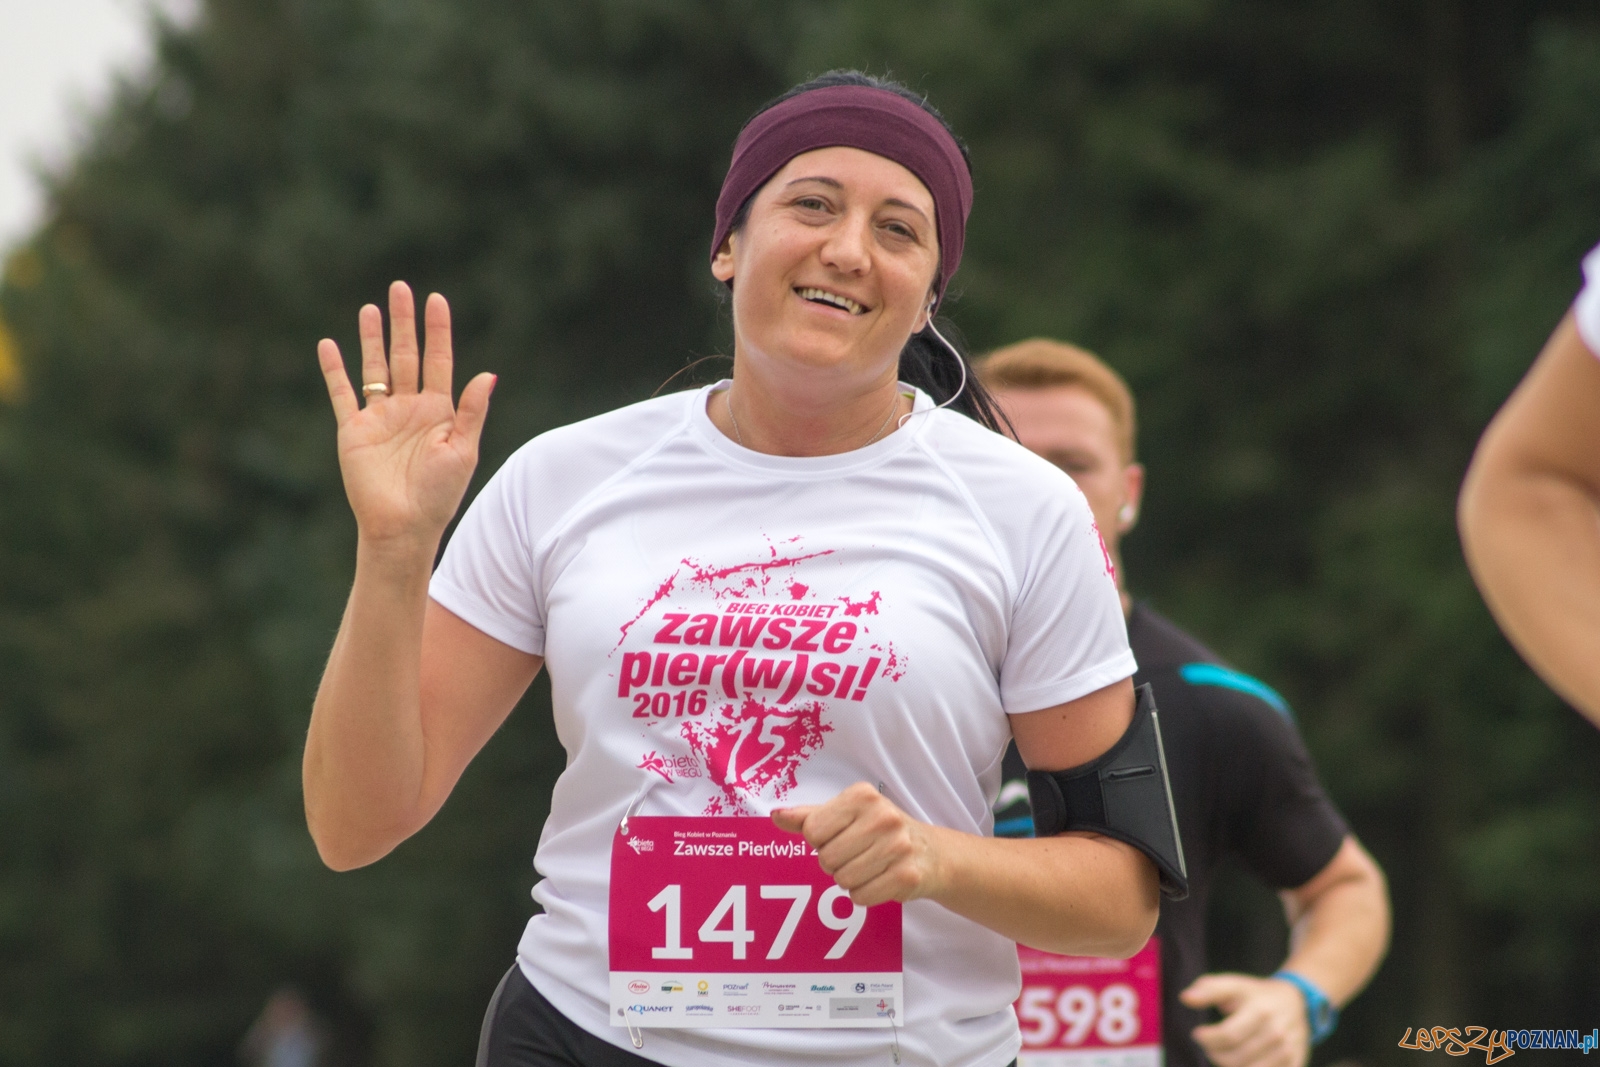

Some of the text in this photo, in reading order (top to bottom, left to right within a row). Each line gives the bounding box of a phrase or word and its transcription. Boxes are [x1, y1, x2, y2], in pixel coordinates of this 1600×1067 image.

[725, 602, 839, 619] BIEG KOBIET
[653, 612, 857, 654] zawsze
[632, 689, 708, 718] 2016
[673, 840, 734, 856] Zawsze
[738, 840, 806, 858] Pier(w)si
[647, 884, 868, 960] 1479
